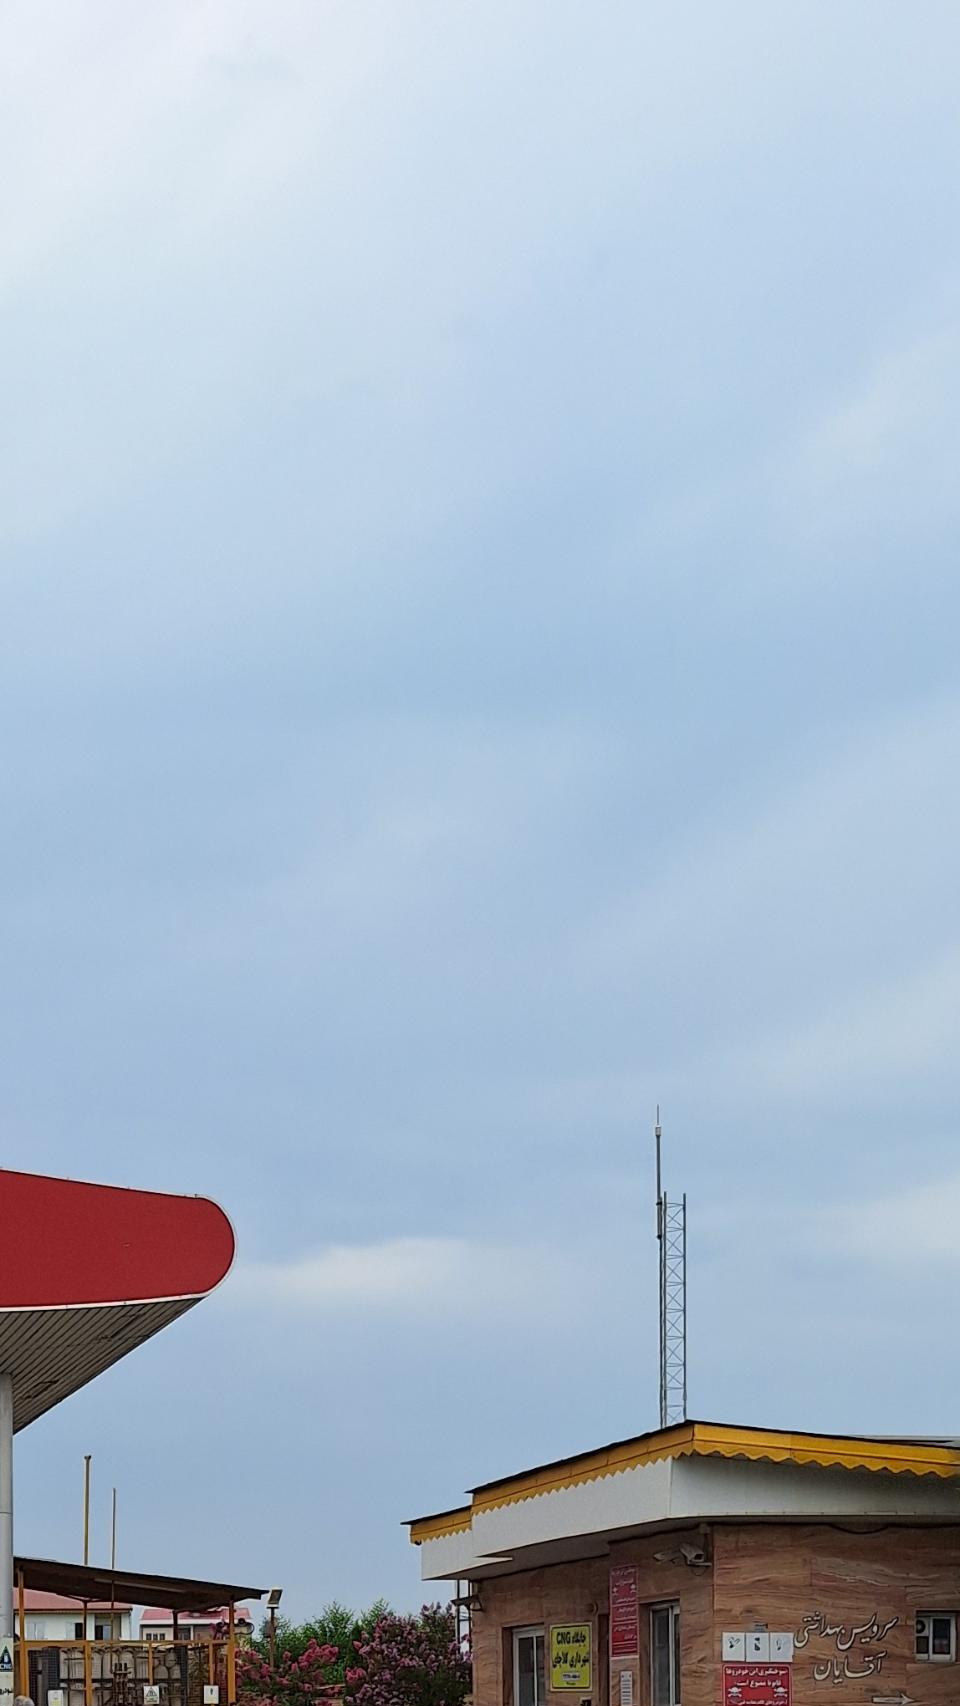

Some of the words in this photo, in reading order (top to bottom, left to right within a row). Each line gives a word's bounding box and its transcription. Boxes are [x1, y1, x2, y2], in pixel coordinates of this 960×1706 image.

[556, 1631, 571, 1645] CNG
[793, 1611, 845, 1648] بهداشتی
[837, 1612, 899, 1651] سرویس
[813, 1650, 887, 1684] آقایان
[0, 1687, 14, 1696] ودرو
